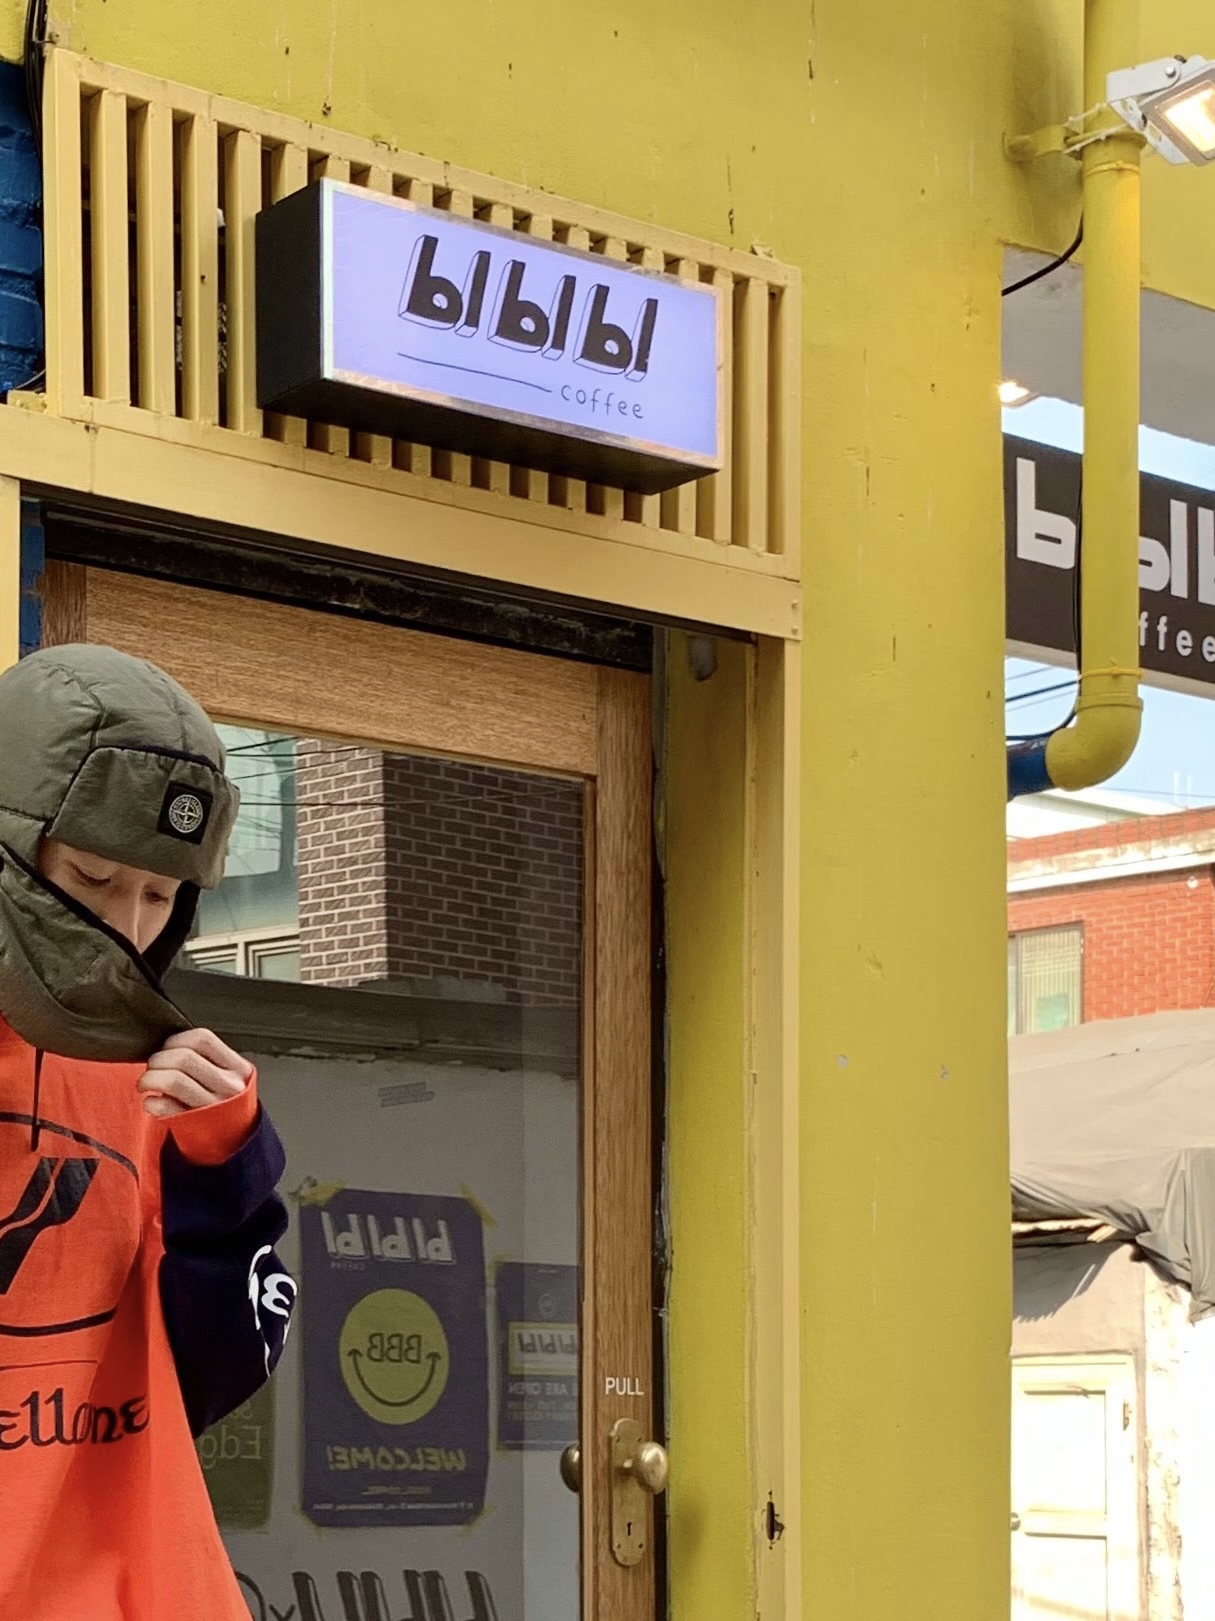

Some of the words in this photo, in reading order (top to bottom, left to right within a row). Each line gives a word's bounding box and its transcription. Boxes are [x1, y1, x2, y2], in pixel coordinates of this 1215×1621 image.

[561, 384, 643, 420] coffee
[1139, 611, 1215, 663] ffee
[605, 1377, 645, 1396] PULL
